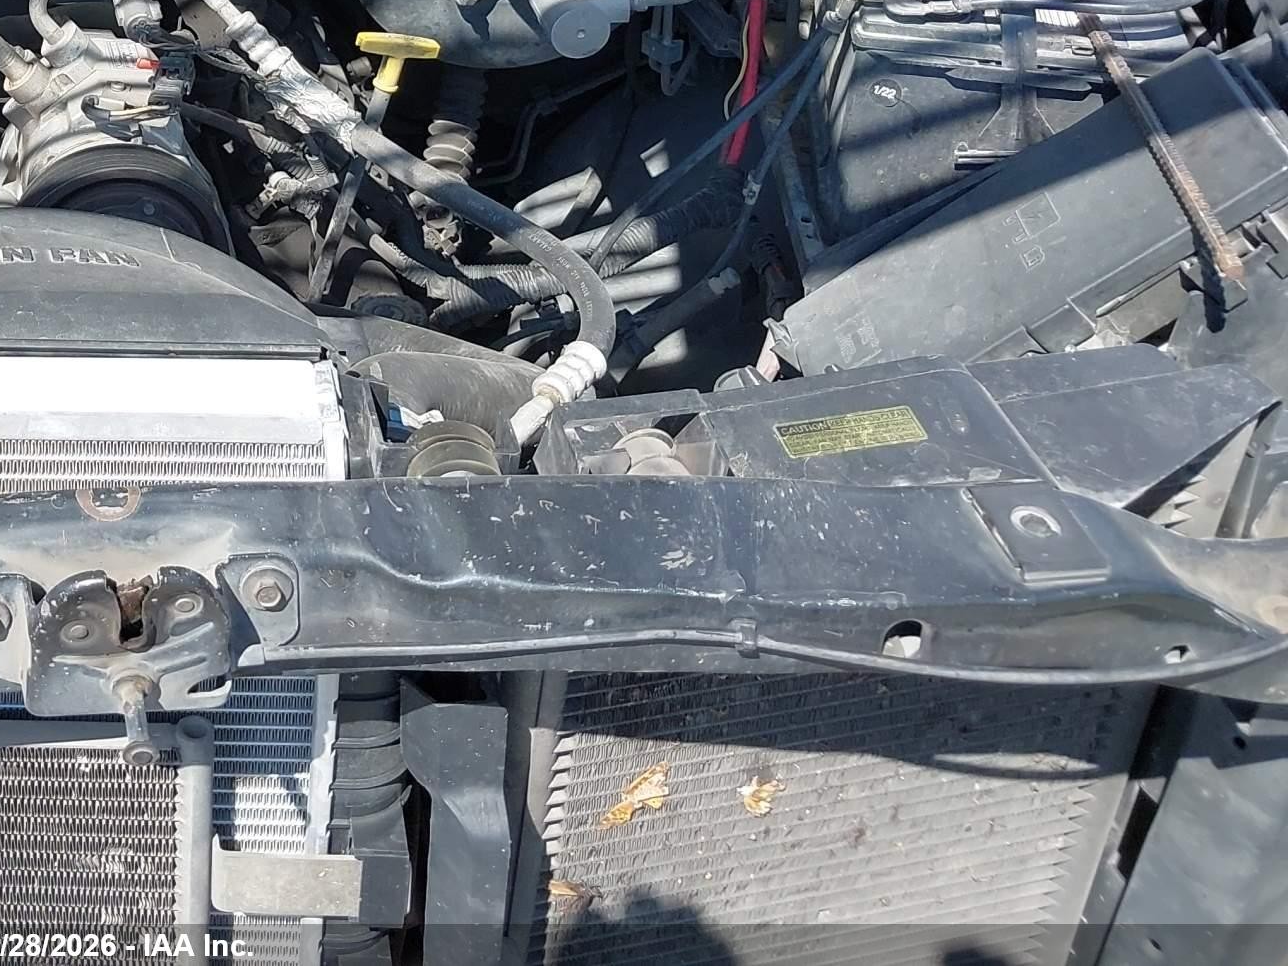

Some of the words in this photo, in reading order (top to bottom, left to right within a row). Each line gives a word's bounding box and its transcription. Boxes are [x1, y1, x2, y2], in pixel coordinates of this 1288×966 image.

[874, 84, 896, 99] 1/22
[50, 247, 141, 267] FAN
[781, 421, 829, 435] CAUTION
